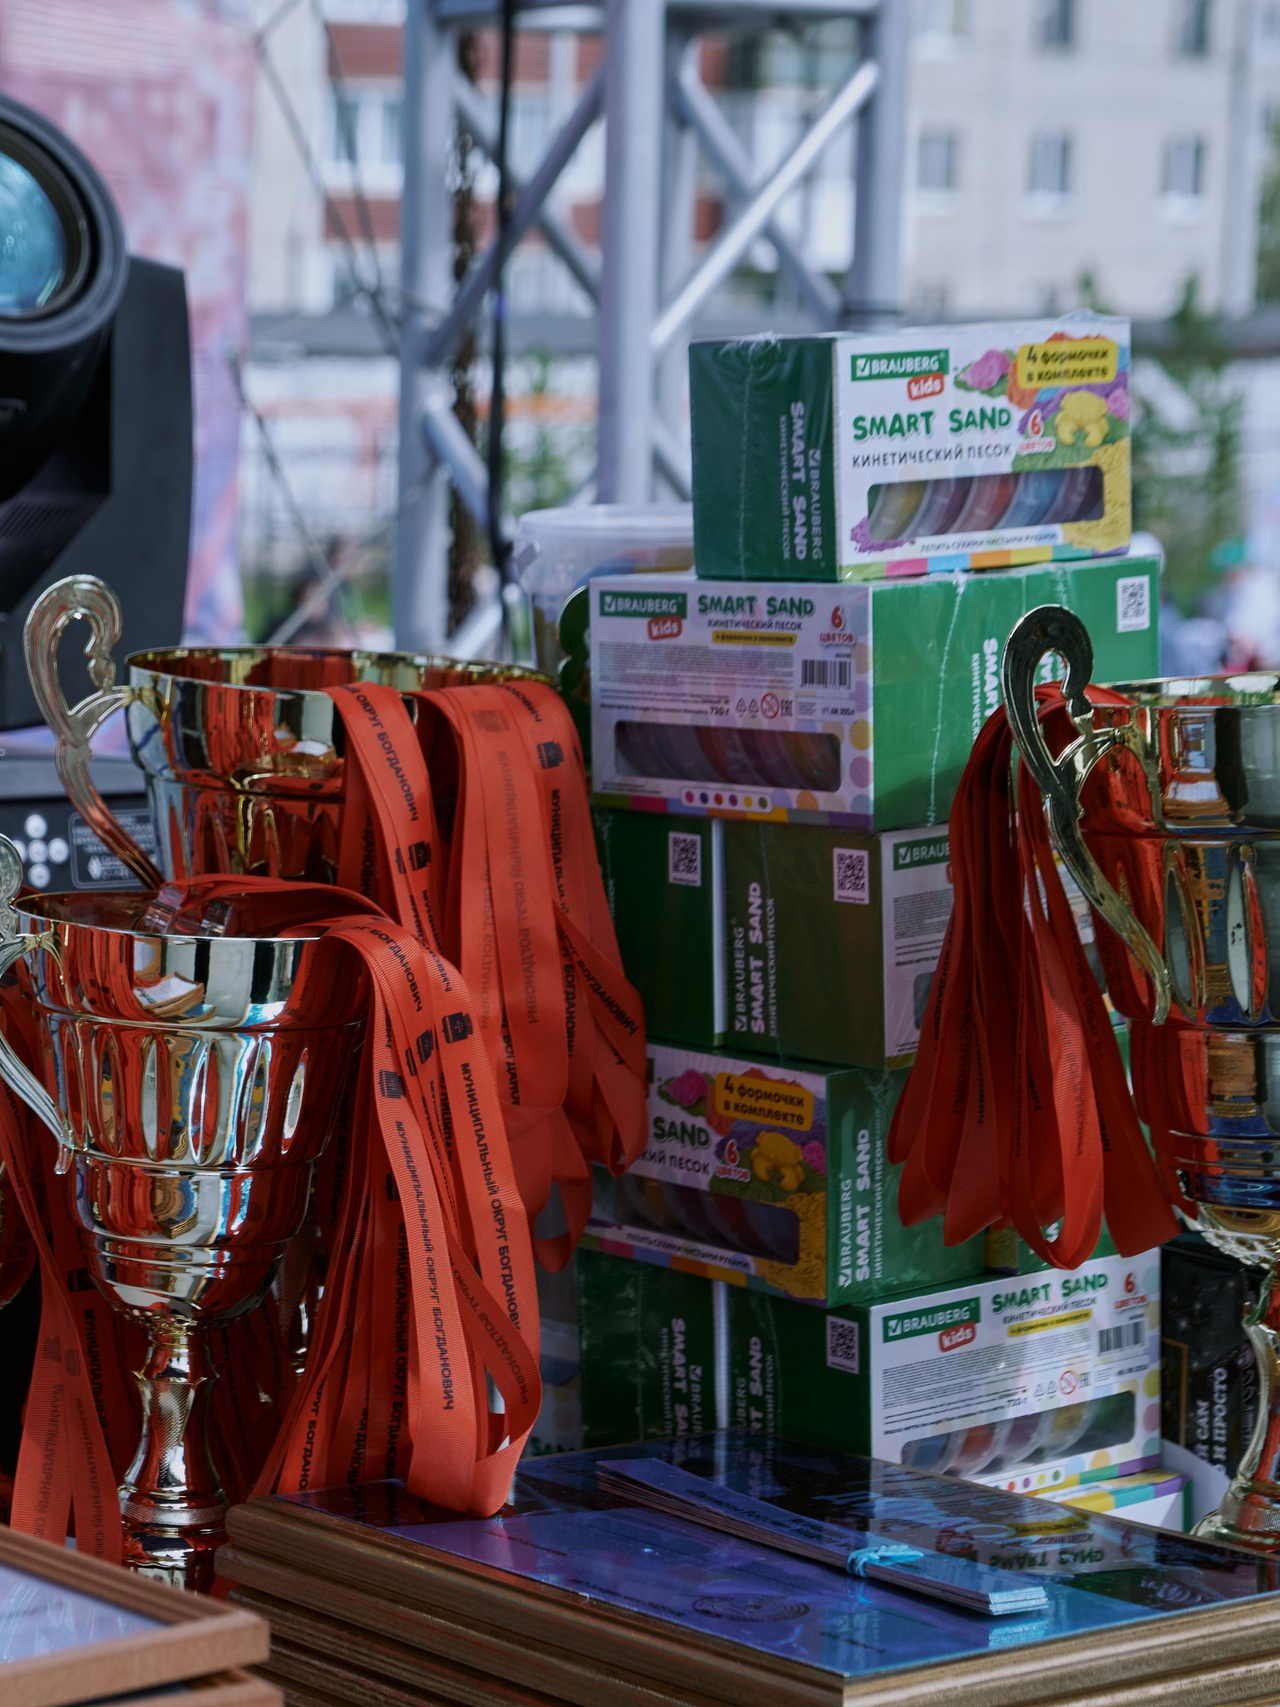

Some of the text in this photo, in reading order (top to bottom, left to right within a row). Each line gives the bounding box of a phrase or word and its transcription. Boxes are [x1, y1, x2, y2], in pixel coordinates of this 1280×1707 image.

[871, 357, 939, 374] BRAUBERG
[1027, 346, 1108, 366] 4 формочки
[910, 376, 942, 400] kids
[1037, 366, 1108, 382] комплекте
[852, 406, 1011, 441] SMART SAND
[1029, 413, 1043, 435] 6
[852, 443, 1011, 468] КИНЕТИЧЕСКИЙ ПЕСОК
[790, 400, 808, 561] SMART SAND
[809, 468, 823, 560] BRAUBERG
[617, 597, 677, 613] BRAUBERG
[698, 594, 815, 616] SMART SAND
[831, 605, 843, 629] 6
[650, 619, 680, 638] kids
[708, 618, 802, 631] КИНЕТИЧЕСКИЙ ПЕСОК
[820, 633, 854, 643] ЦВЕТОВ
[356, 693, 419, 822] ОКРУГ БОГДАНОВИЧ
[368, 927, 423, 1013] БОГДАНОВИЧ
[734, 926, 746, 1013] BRAUBERG
[748, 881, 766, 1034] SMART SAND
[576, 958, 639, 1036] БОГДАНОВИЧ
[724, 1075, 805, 1108] 4 формочки
[723, 1100, 805, 1126] в комплекте
[653, 1116, 711, 1148] SAND
[461, 1062, 502, 1196] МУНИЦИПАЛЬНЫЙ
[491, 1200, 509, 1243] ОКРУГ
[670, 1155, 710, 1176] ПЕСОК
[726, 1140, 738, 1165] 6
[717, 1166, 750, 1181] ЦВЕТОВ
[840, 1178, 851, 1266] BRAUBERG
[856, 1129, 871, 1282] SMART SAND
[874, 1139, 883, 1278] КИНЕТИЧЕСКИЙ ПЕСОК
[395, 1120, 454, 1411] МУНИЦИПАЛЬНЫЙ ОКРУГ БОГДАНОВИЧ
[992, 1273, 1108, 1313] SMART SAND
[1124, 1272, 1136, 1294] 6
[903, 1307, 970, 1332] BRAUBERG
[941, 1326, 973, 1349] kids
[672, 1317, 687, 1393] SMART
[749, 1336, 762, 1397] SAND
[393, 1356, 407, 1399] ОКРУГ
[735, 1377, 747, 1430] UBERG
[1212, 1367, 1228, 1443] ПРОСТО
[297, 1419, 317, 1491] БОГДАНО
